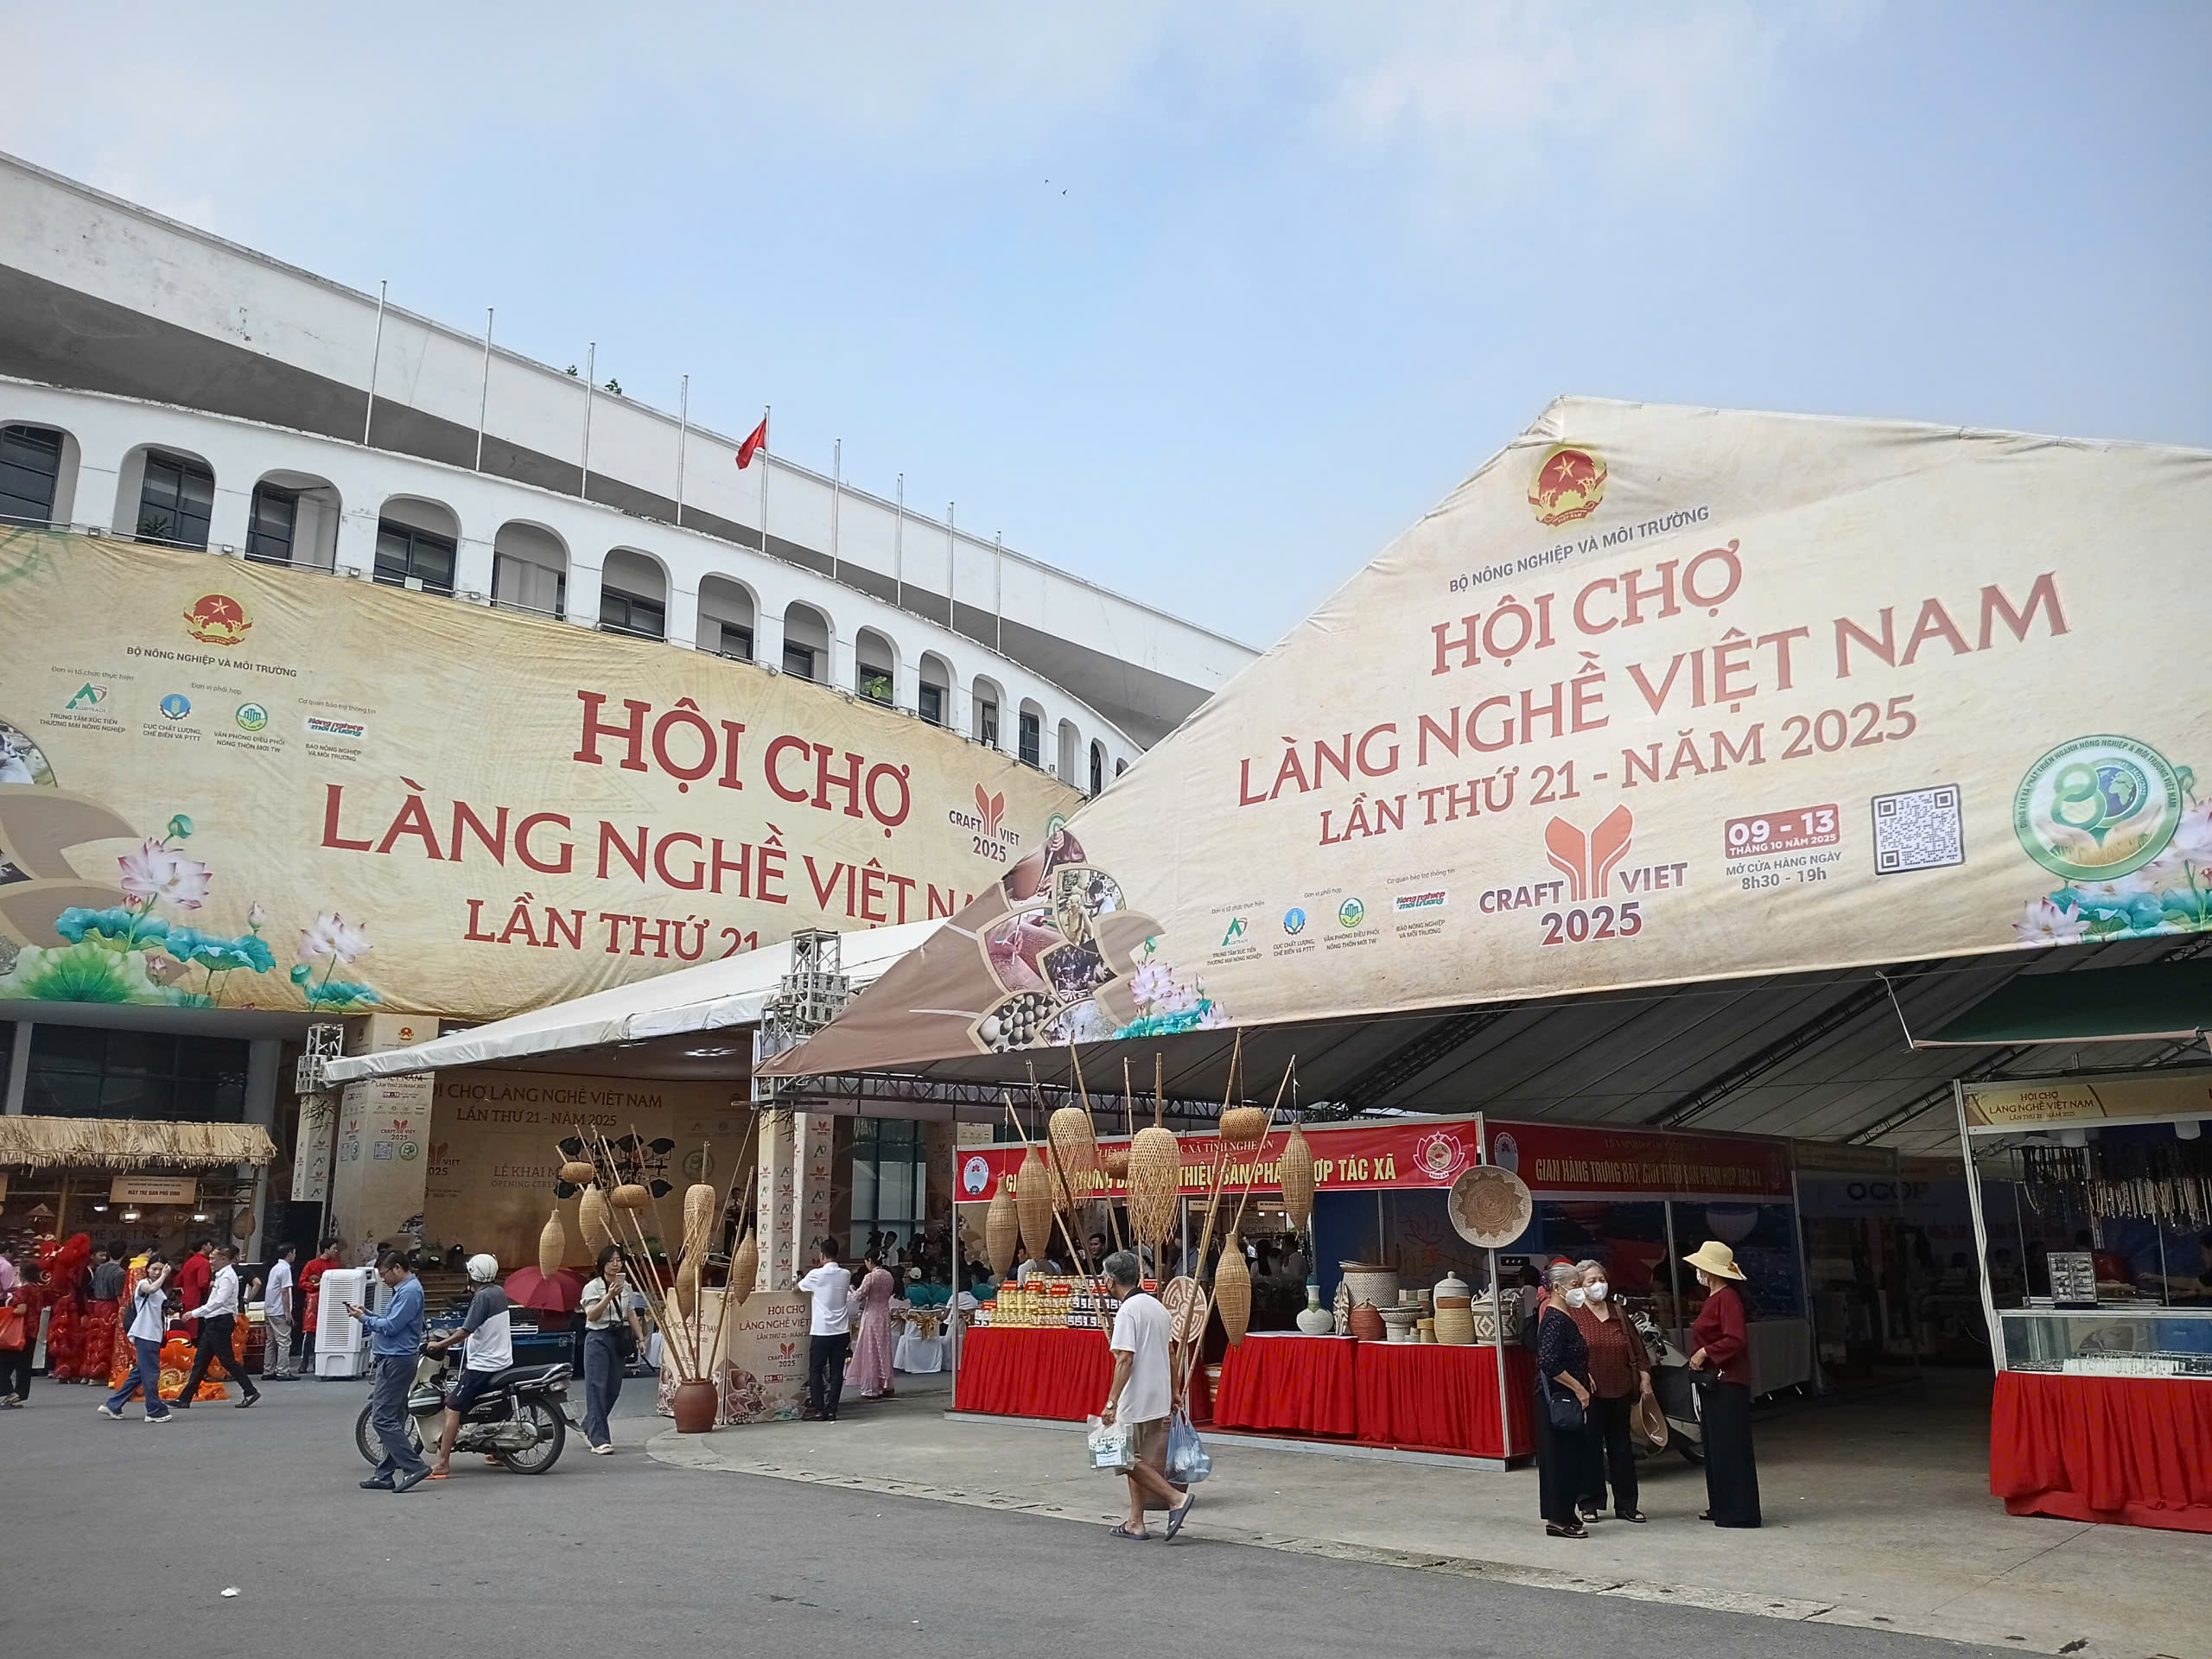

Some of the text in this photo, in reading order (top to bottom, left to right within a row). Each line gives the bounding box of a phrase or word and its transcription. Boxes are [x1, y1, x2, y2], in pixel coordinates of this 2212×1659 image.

[1449, 506, 1710, 593] BỘ NÔNG NGHIỆP VÀ MÔI TRƯỜNG
[1431, 539, 1742, 676] HỘI CHỢ
[127, 646, 297, 678] BỘ NÔNG NGHIỆP VÀ MÔI TRƯỜNG
[1238, 570, 2071, 807] LÀNG NGHỀ VIỆT NAM
[573, 690, 911, 838] HỘI CHỢ
[1319, 694, 1917, 846] LẦN THỨ 21 - NĂM 2025
[949, 810, 1020, 847] CRAFT VIET
[1728, 820, 1770, 846] 09
[1801, 810, 1835, 835] 13
[321, 776, 575, 874] LÀNG
[596, 821, 788, 905] NGHỀ
[802, 856, 917, 928] VIỆT
[973, 836, 1007, 863] 2025
[1729, 842, 1768, 856] THÁNG
[1785, 836, 1808, 849] NĂM
[1811, 834, 1836, 844] 2025
[1726, 851, 1842, 876] MỞ CỬA HÀNG NGÀY
[1742, 874, 1780, 890] 8h30
[1797, 867, 1827, 883] 19h
[1479, 862, 1688, 914] CRAFT VIET
[464, 892, 759, 961] LẦN THỨ 21
[1541, 901, 1643, 946] 2025
[448, 1084, 488, 1103] CHỢ
[490, 1083, 538, 1103] LÀNG
[542, 1086, 588, 1105] NGHỀ
[590, 1089, 624, 1109] VIỆT
[626, 1093, 662, 1109] NAM
[2018, 1100, 2045, 1112] NGHỀ
[2046, 1099, 2068, 1110] VIỆT
[2070, 1099, 2094, 1109] NAM
[456, 1107, 489, 1122] LẦN
[492, 1108, 524, 1123] THỨ
[526, 1111, 540, 1123] 21
[551, 1110, 585, 1126] NĂM
[588, 1114, 617, 1128] 2025
[1188, 1141, 1201, 1154] XÃ
[1230, 1141, 1257, 1153] NGHỆ
[427, 1166, 448, 1176] 025
[1179, 1160, 1215, 1191] THIỆU
[1254, 1153, 1282, 1184] PHẨ
[1313, 1158, 1333, 1187] ỢP
[1338, 1154, 1368, 1181] TÁC
[1373, 1153, 1396, 1180] XÃ
[1535, 1159, 1560, 1182] GIAN
[1562, 1155, 1588, 1183] HÀNG
[1589, 1158, 1621, 1183] TRƯNG
[491, 1180, 558, 1189] OPENING CERE
[739, 1317, 810, 1331] LÀNG NGHỀ VIỆT
[767, 1306, 785, 1316] HỘI
